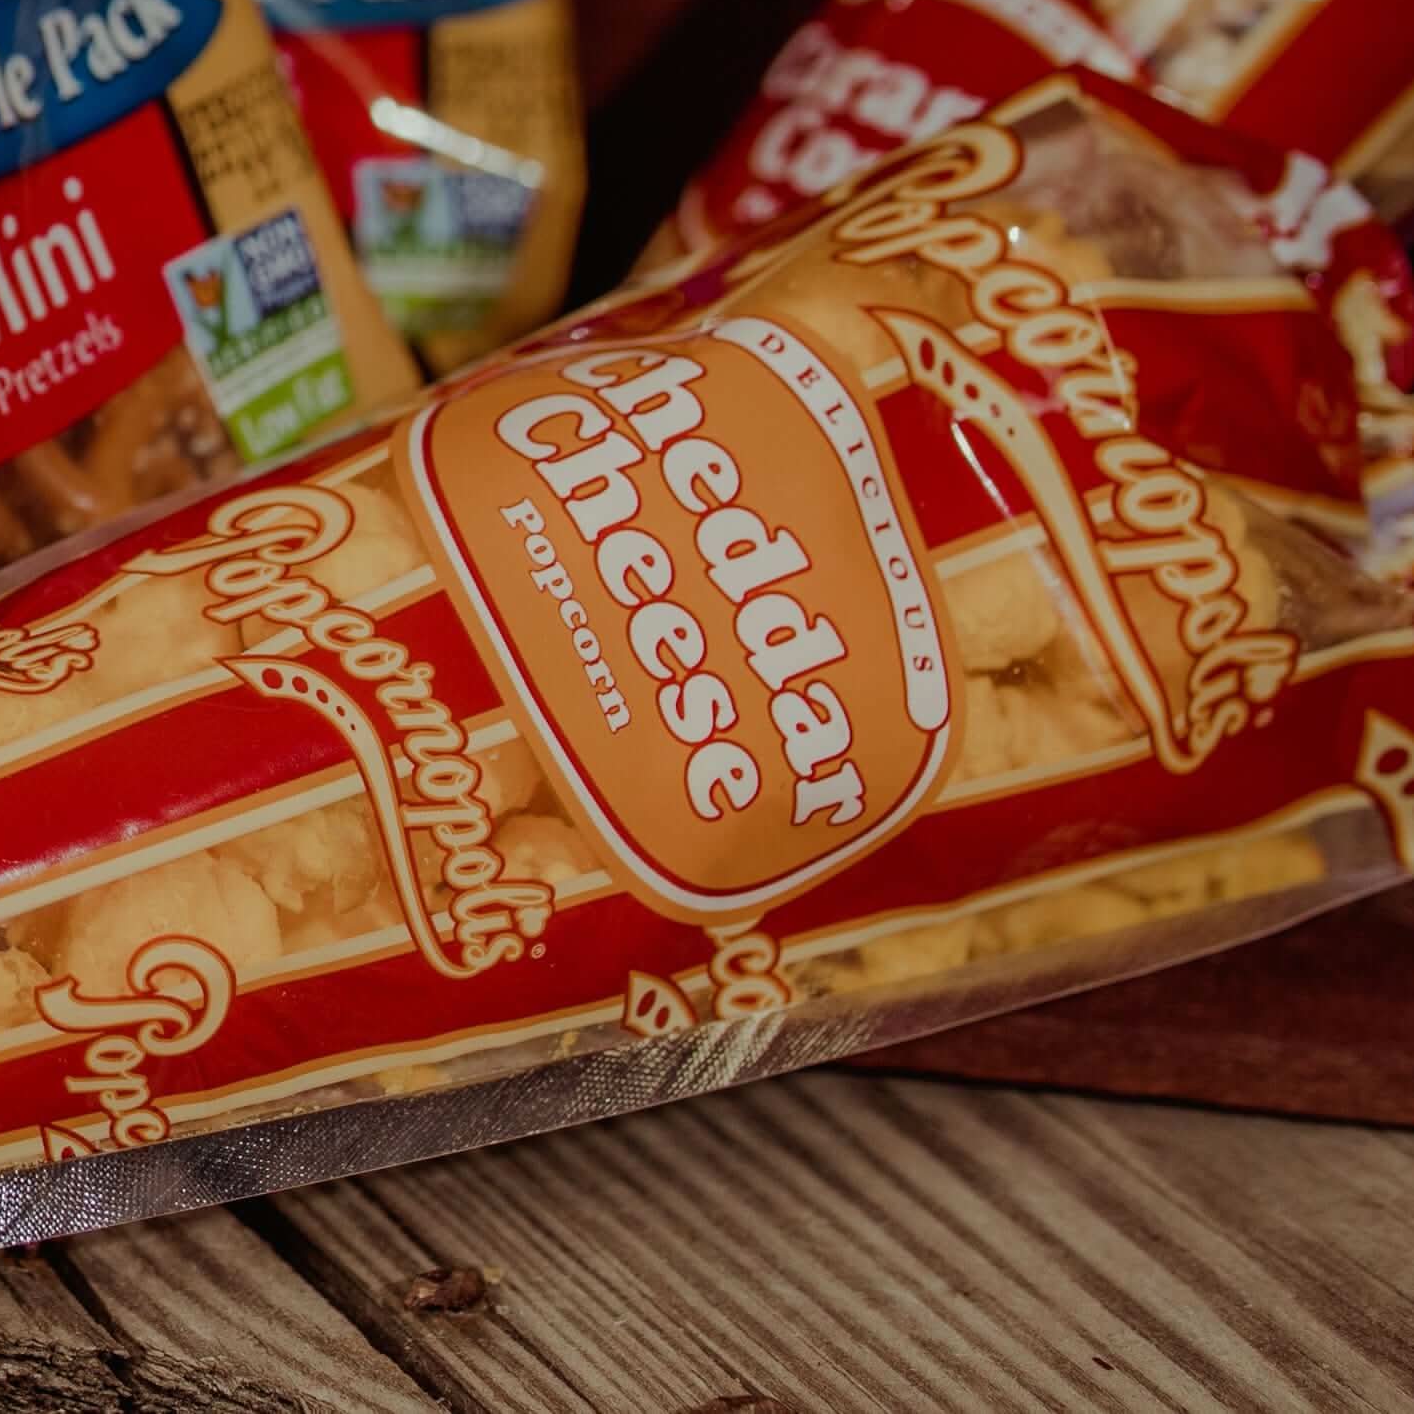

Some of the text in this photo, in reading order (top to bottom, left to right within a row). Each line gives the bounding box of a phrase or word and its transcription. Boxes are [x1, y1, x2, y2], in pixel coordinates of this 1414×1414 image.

[494, 393, 762, 820] Cheese
[499, 496, 632, 735] Popcorn
[561, 349, 867, 827] Cheddar
[759, 332, 934, 674] DELICIOUS
